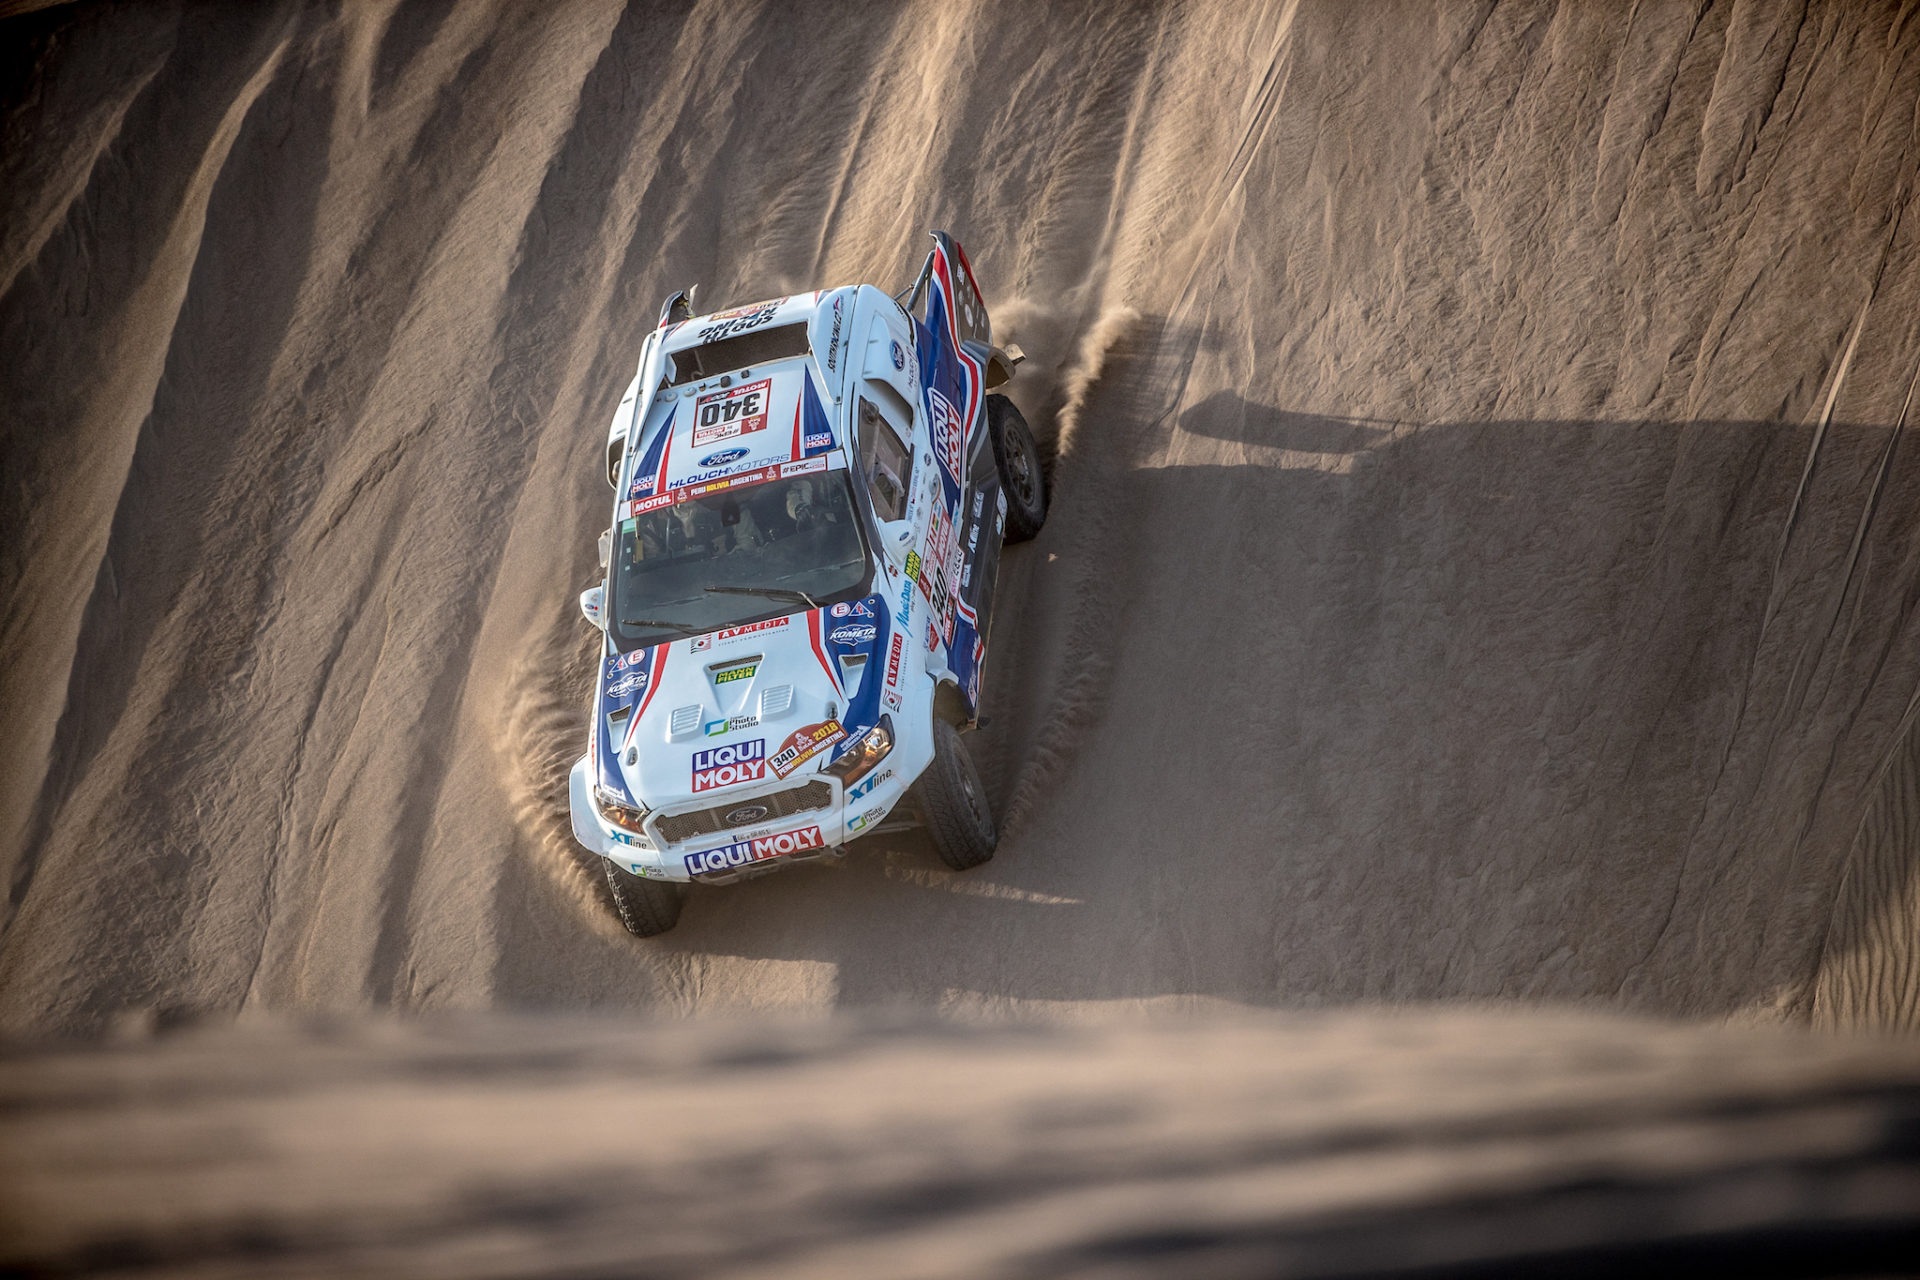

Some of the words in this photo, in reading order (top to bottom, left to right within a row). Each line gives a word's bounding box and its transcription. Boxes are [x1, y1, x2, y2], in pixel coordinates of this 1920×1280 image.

[733, 381, 768, 396] MOTUL
[701, 393, 760, 427] 340
[932, 393, 950, 466] LIQUI
[806, 439, 830, 448] MOLY
[948, 405, 960, 478] MOLY
[632, 481, 653, 492] MOLY
[634, 475, 655, 485] LIQUI
[691, 486, 706, 496] PERU
[706, 481, 730, 492] BOLIVIA
[730, 473, 763, 486] ARGENTINA
[635, 495, 671, 511] MOTUL
[905, 550, 916, 575] MANN
[911, 556, 921, 583] FILTER
[931, 566, 948, 628] 340
[837, 605, 845, 614] E
[830, 627, 877, 640] KOMETA
[632, 653, 641, 662] E
[717, 671, 754, 683] FILTER
[718, 666, 755, 677] MANN
[606, 674, 648, 694] KOMETA
[729, 716, 757, 726] Photo
[729, 721, 759, 731] Studio
[773, 748, 796, 767] 340
[812, 722, 838, 741] 2018
[695, 740, 763, 770] LIQUI
[778, 761, 793, 777] PERU
[791, 750, 814, 766] BOLIVIA
[811, 731, 845, 754] ARGENTINA
[695, 760, 764, 791] MOLY
[735, 811, 757, 822] Ford
[687, 842, 751, 876] LIQUI
[753, 827, 820, 858] MOLY
